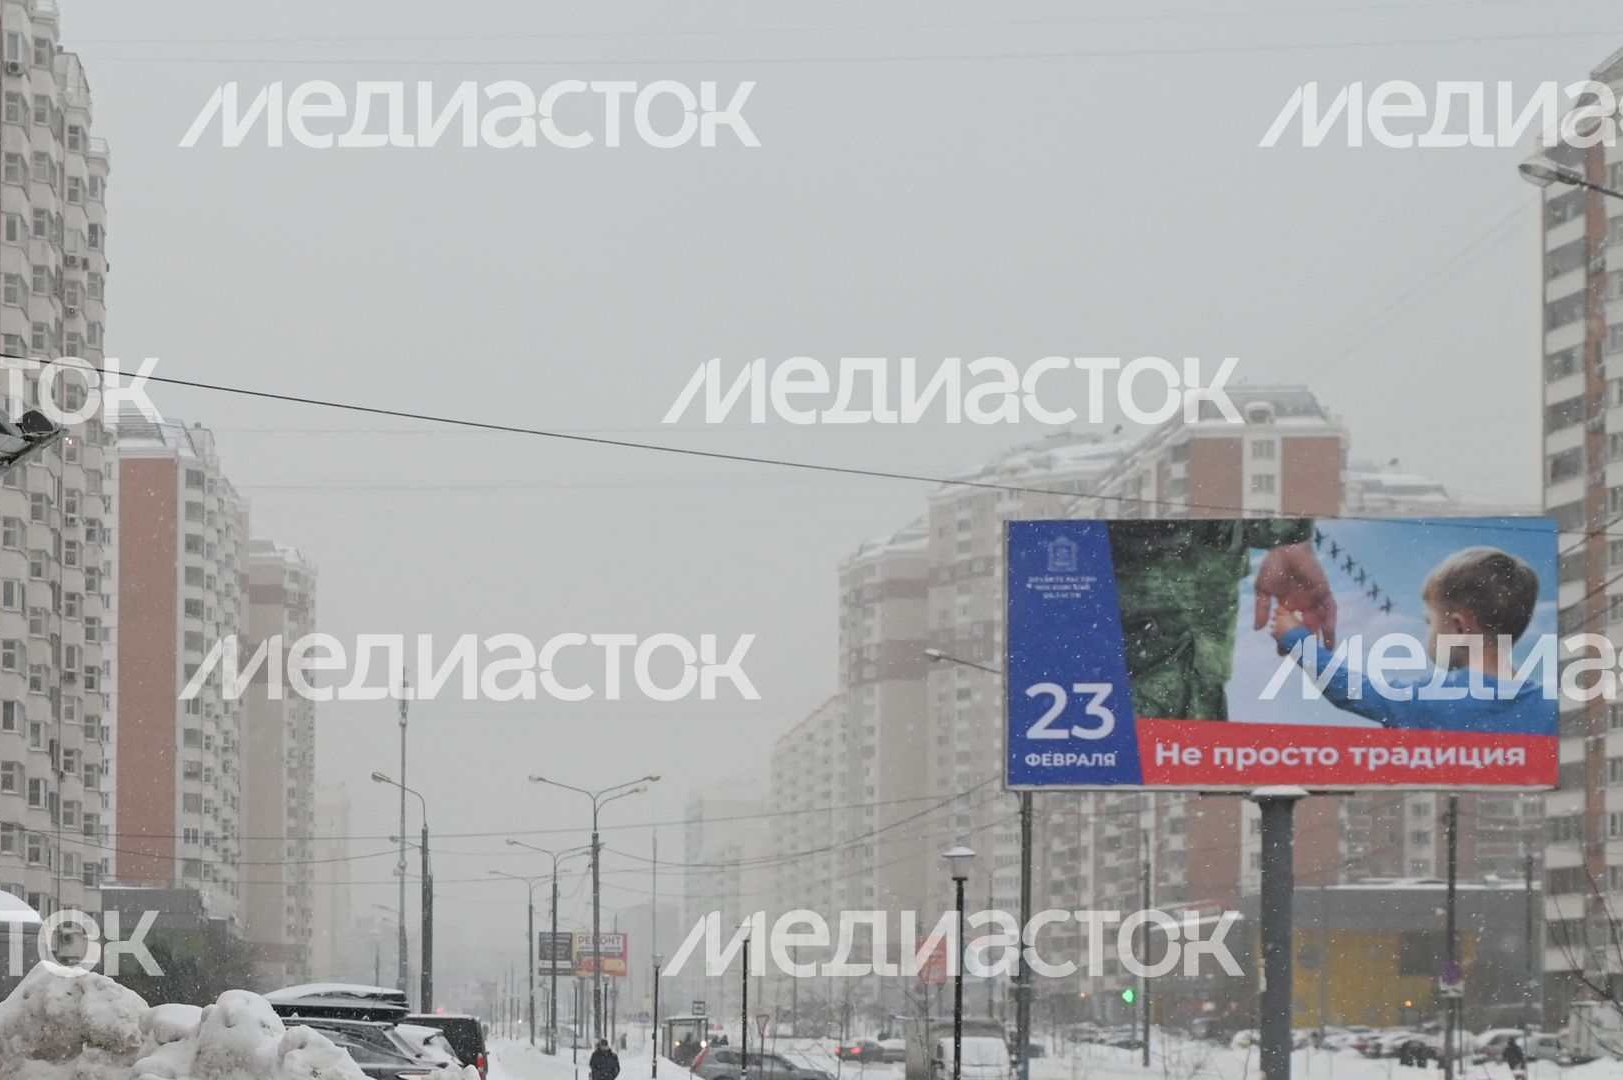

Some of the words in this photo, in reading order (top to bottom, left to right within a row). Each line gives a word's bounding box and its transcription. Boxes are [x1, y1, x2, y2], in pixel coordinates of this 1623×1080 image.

[1024, 682, 1116, 740] 23
[1024, 752, 1116, 767] ФЕВРАЛЯ
[1155, 742, 1202, 766] Не
[1213, 746, 1340, 770] просто
[1348, 745, 1526, 771] традиция
